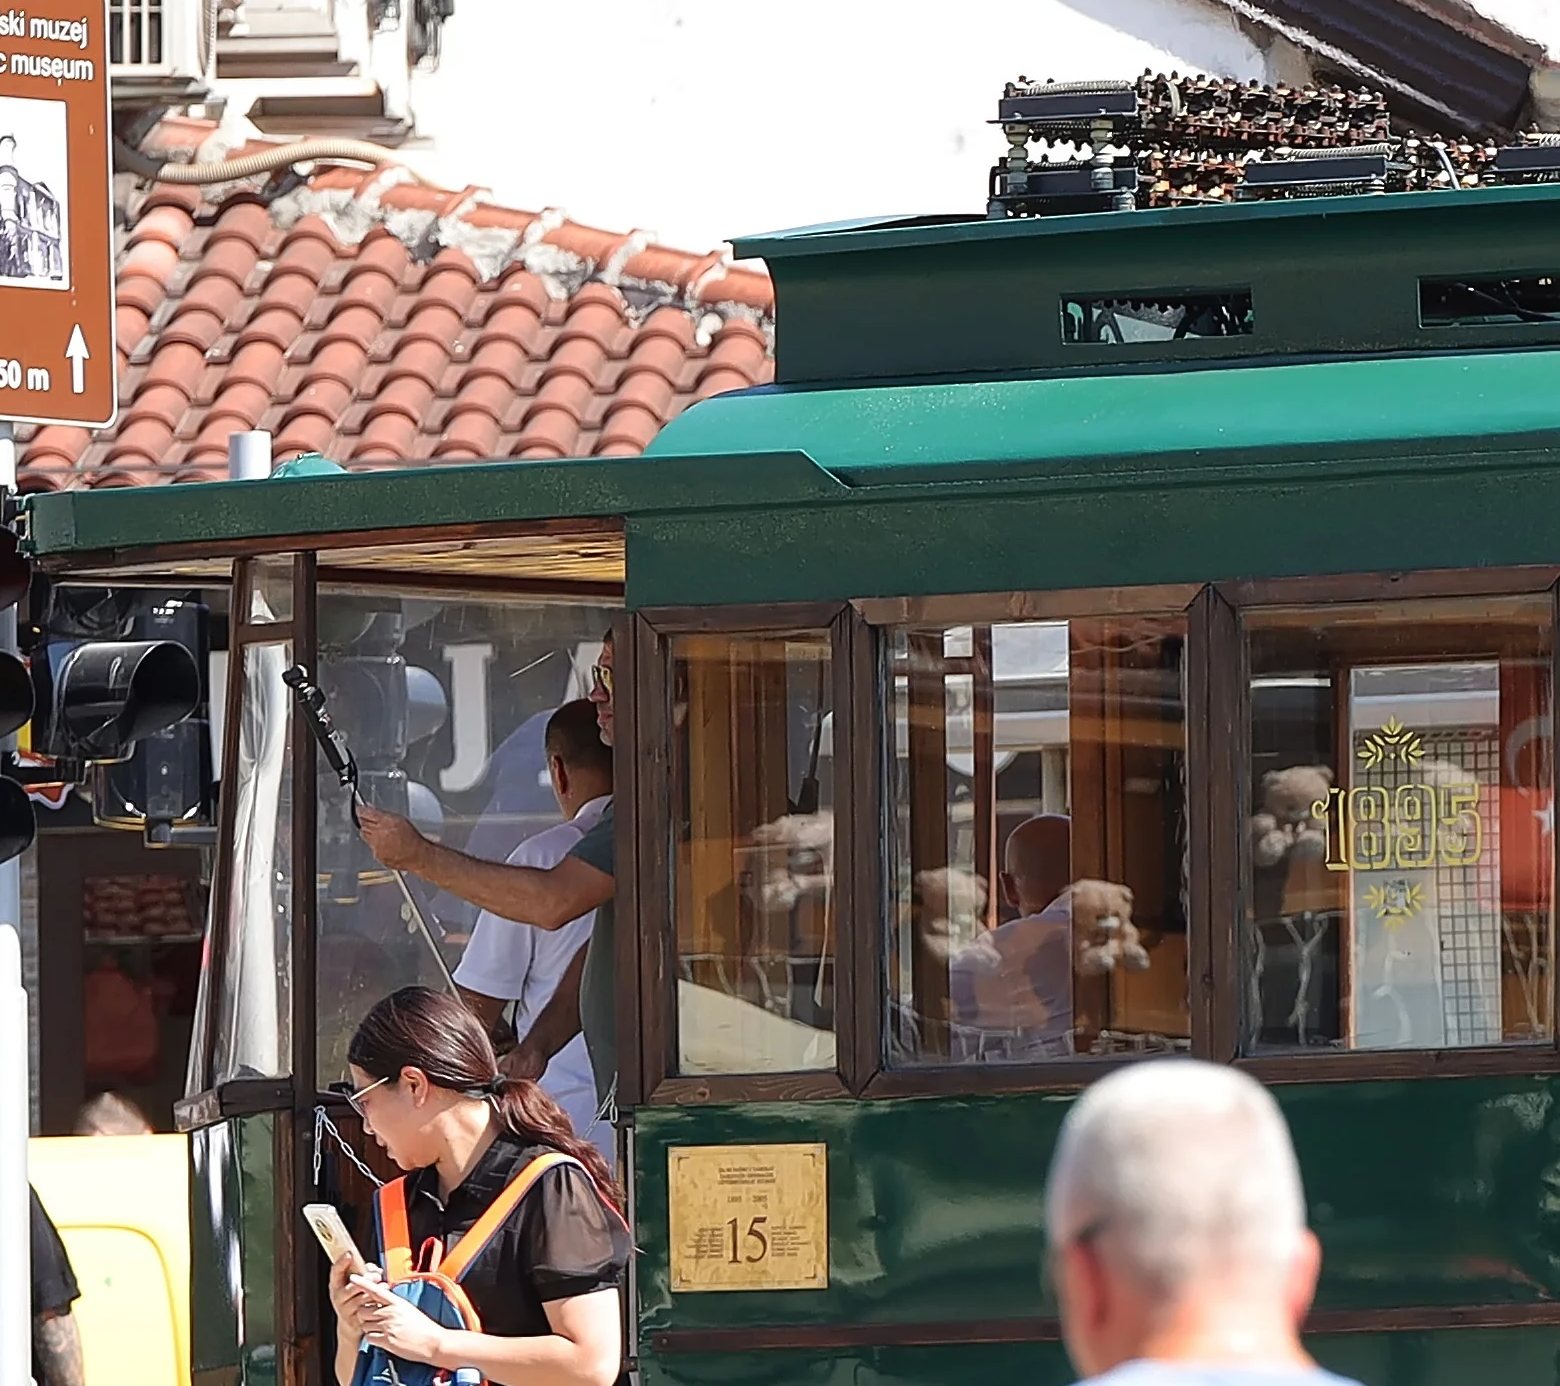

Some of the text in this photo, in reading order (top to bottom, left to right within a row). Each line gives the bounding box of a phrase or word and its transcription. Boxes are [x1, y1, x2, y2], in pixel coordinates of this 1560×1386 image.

[29, 16, 88, 50] muzej
[10, 53, 94, 82] museum
[27, 367, 50, 391] m
[1312, 782, 1483, 871] 1895
[727, 1216, 768, 1265] 15
